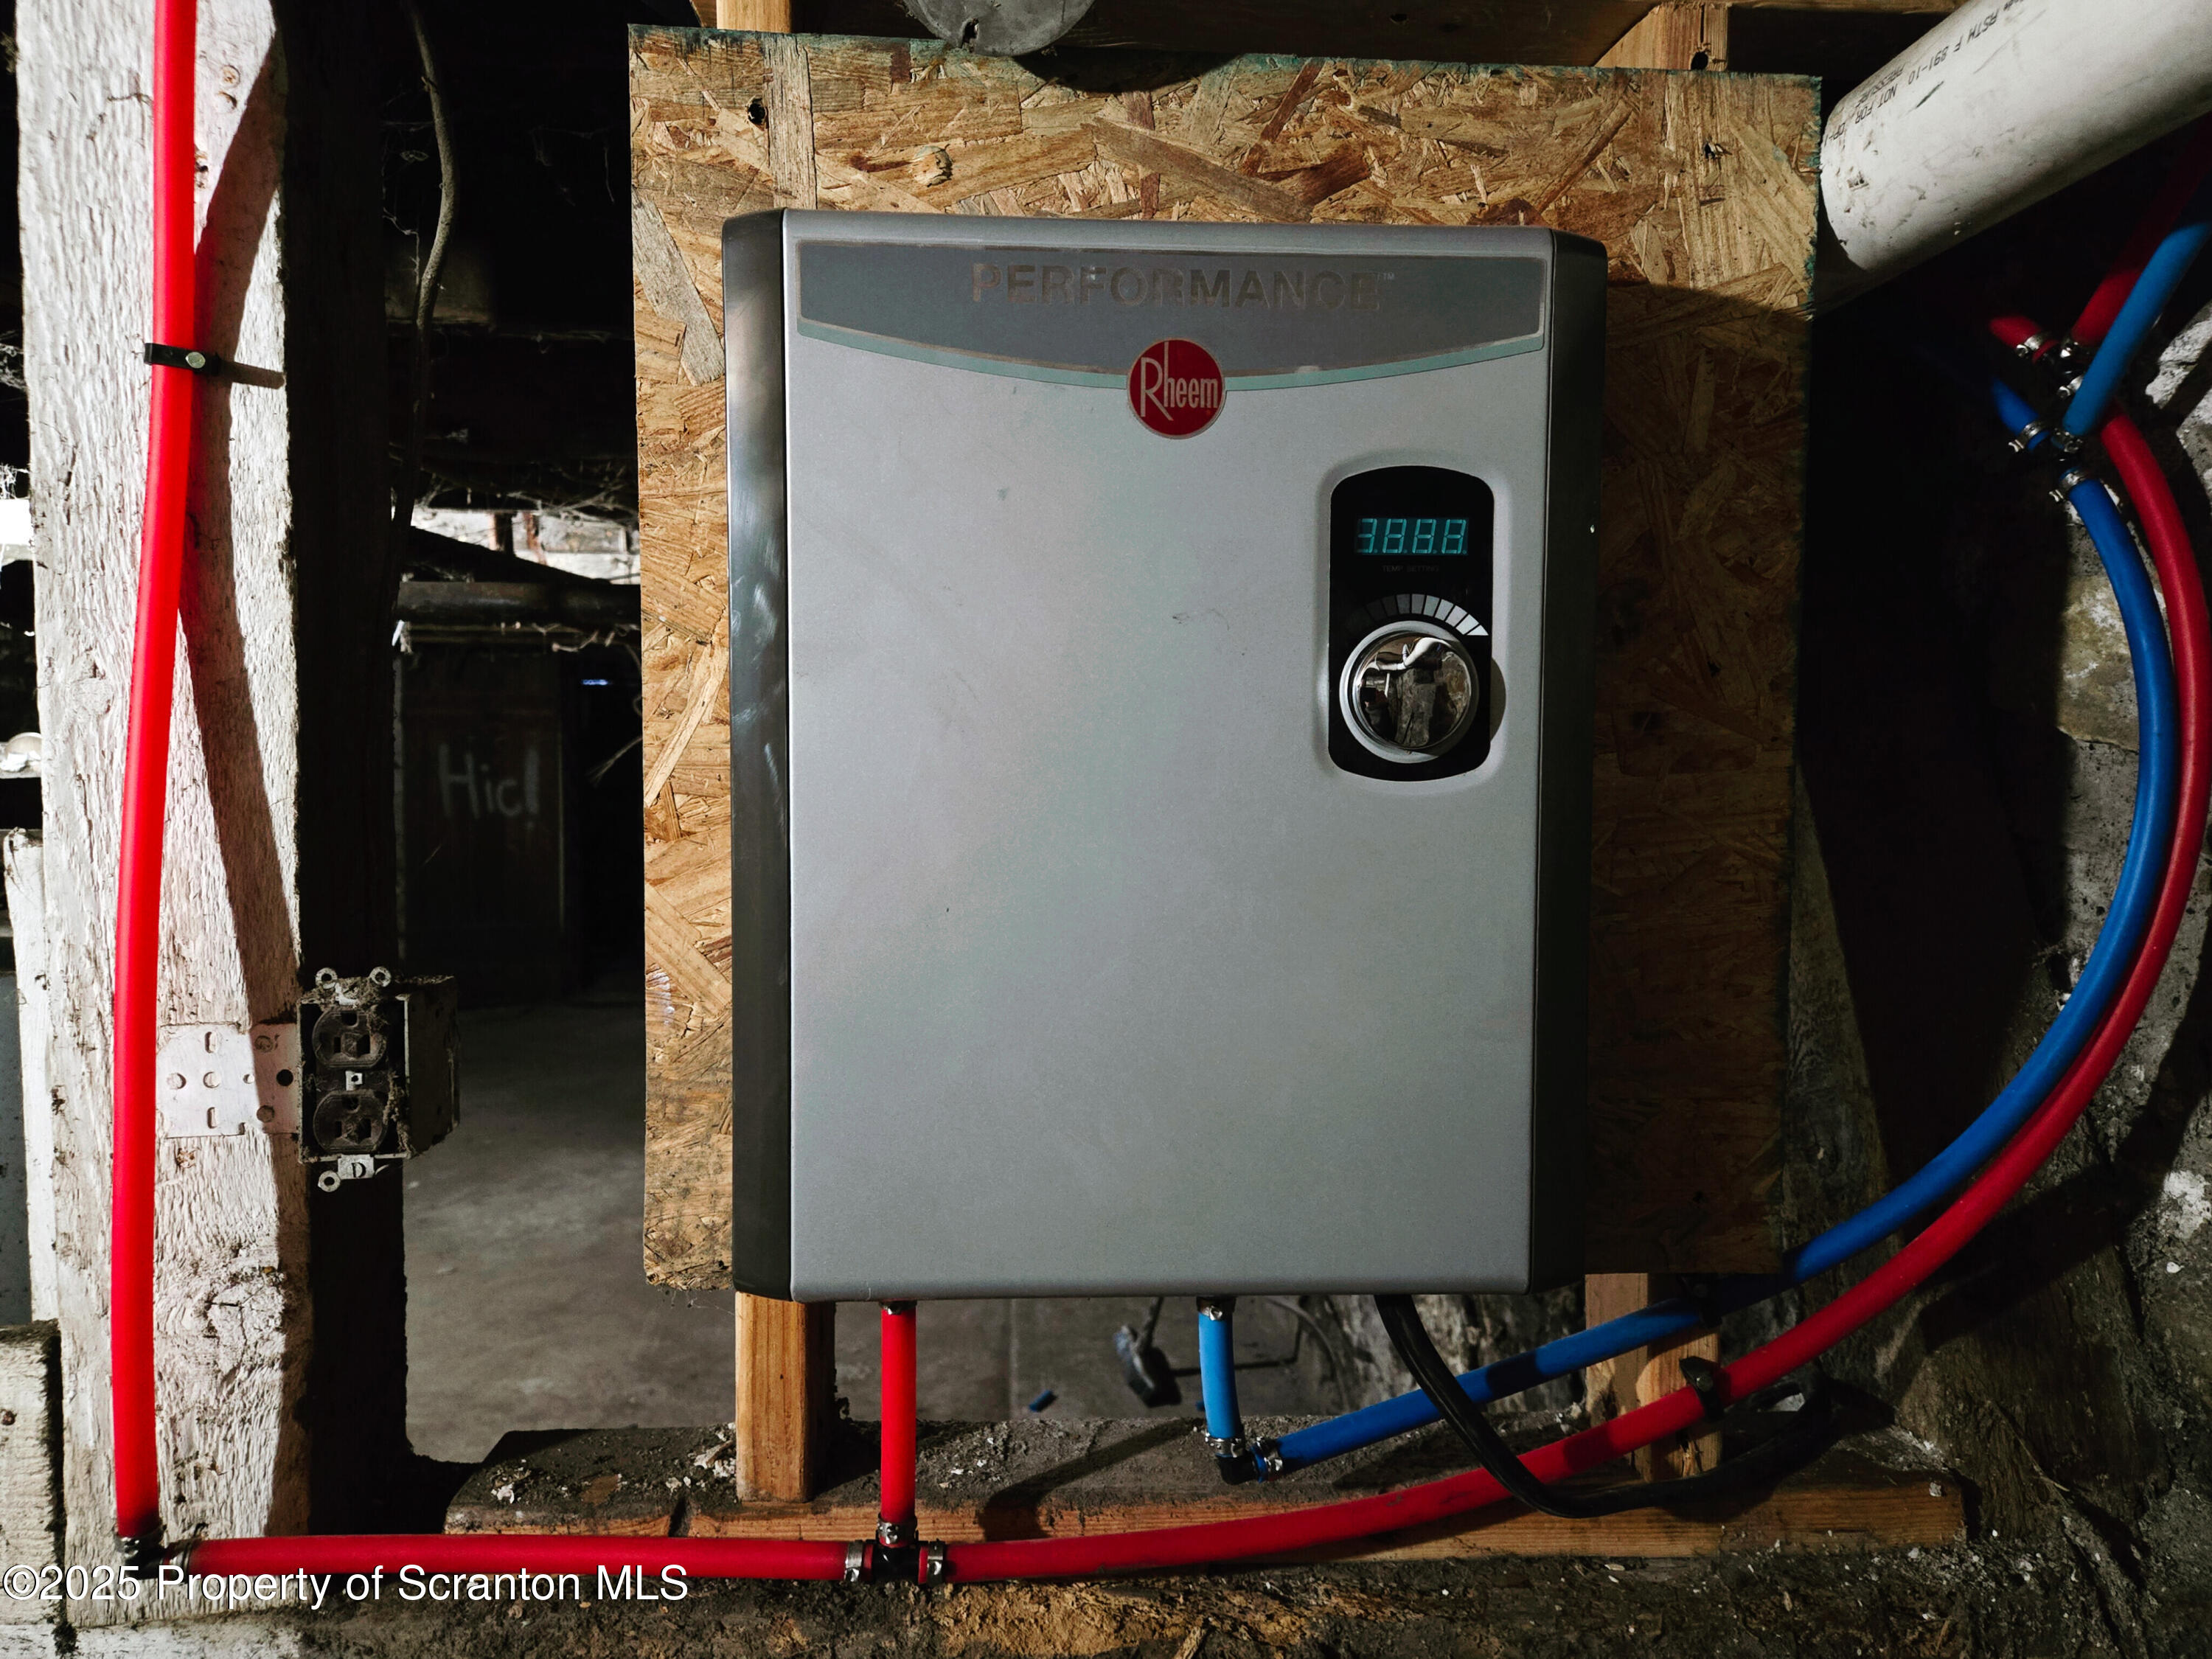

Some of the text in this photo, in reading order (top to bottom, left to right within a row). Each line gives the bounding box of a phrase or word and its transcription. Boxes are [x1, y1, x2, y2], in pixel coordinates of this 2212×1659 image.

[1967, 10, 1999, 44] ASTM
[1953, 35, 1963, 52] F
[1877, 83, 1898, 108] NOT
[1854, 100, 1874, 124] FOR
[1139, 341, 1219, 421] Rheem
